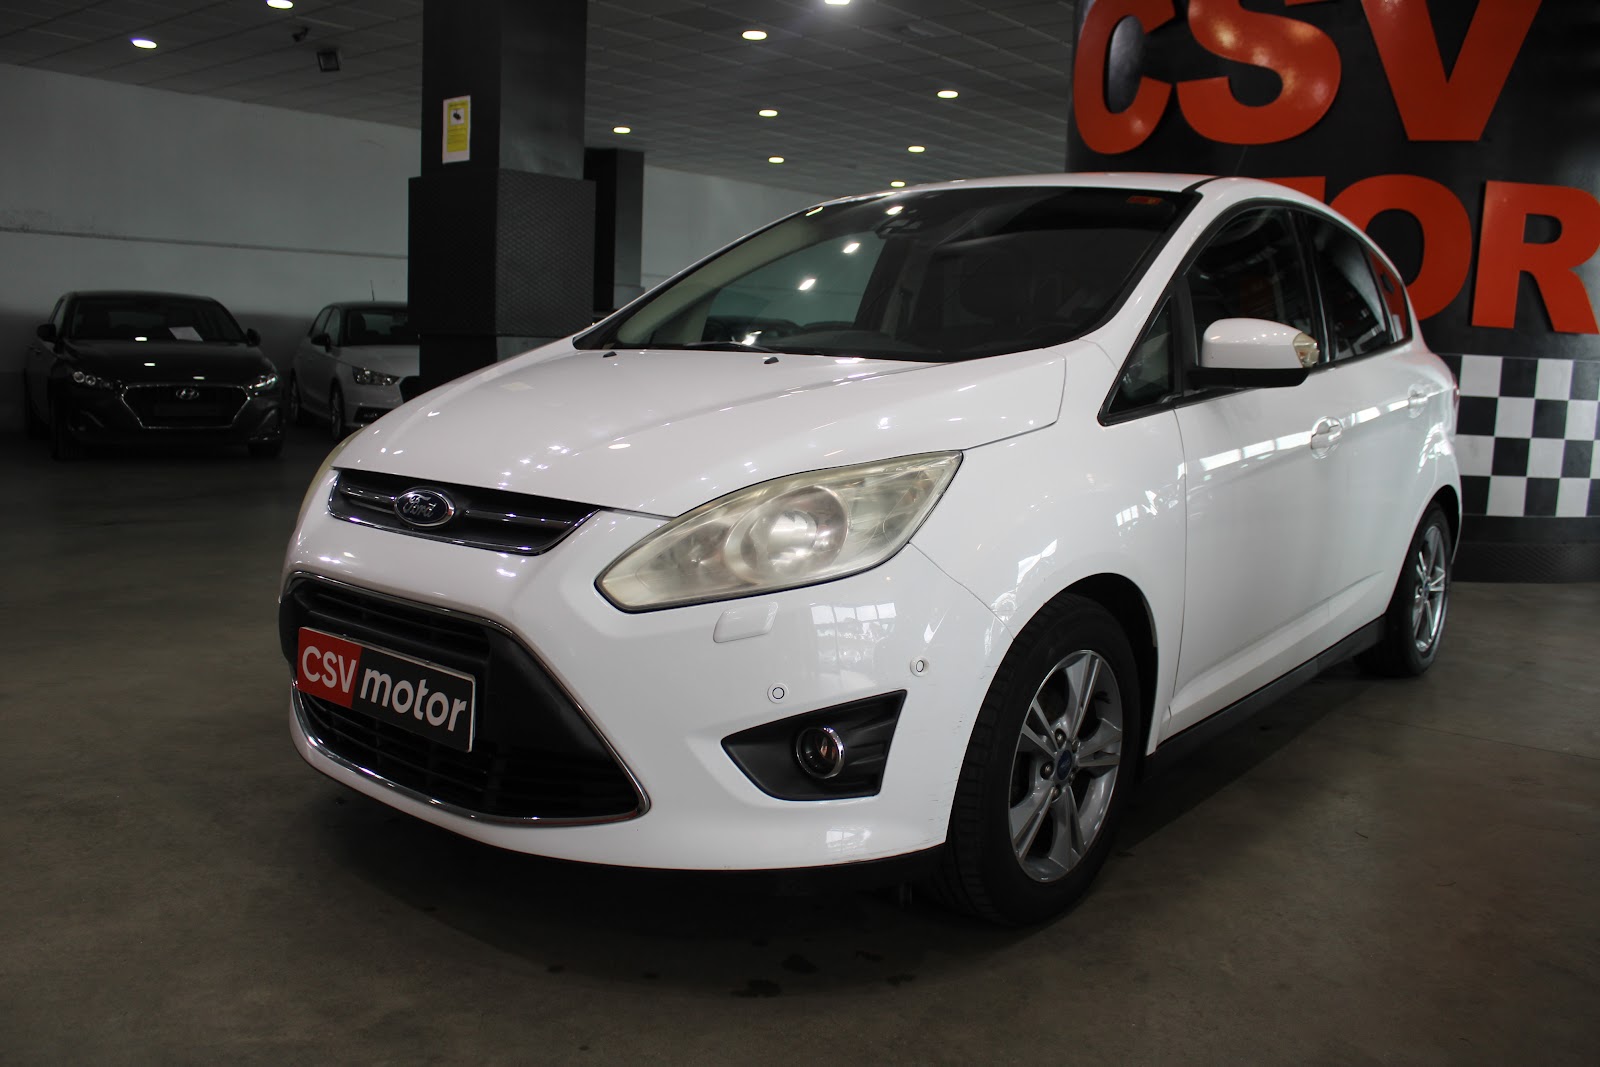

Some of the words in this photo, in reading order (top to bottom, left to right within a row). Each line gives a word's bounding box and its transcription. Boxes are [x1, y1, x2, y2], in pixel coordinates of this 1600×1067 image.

[1074, 0, 1541, 154] CSV
[1256, 174, 1600, 335] OR
[402, 494, 437, 517] Ford
[302, 646, 356, 693] CSV
[360, 668, 467, 732] motor
